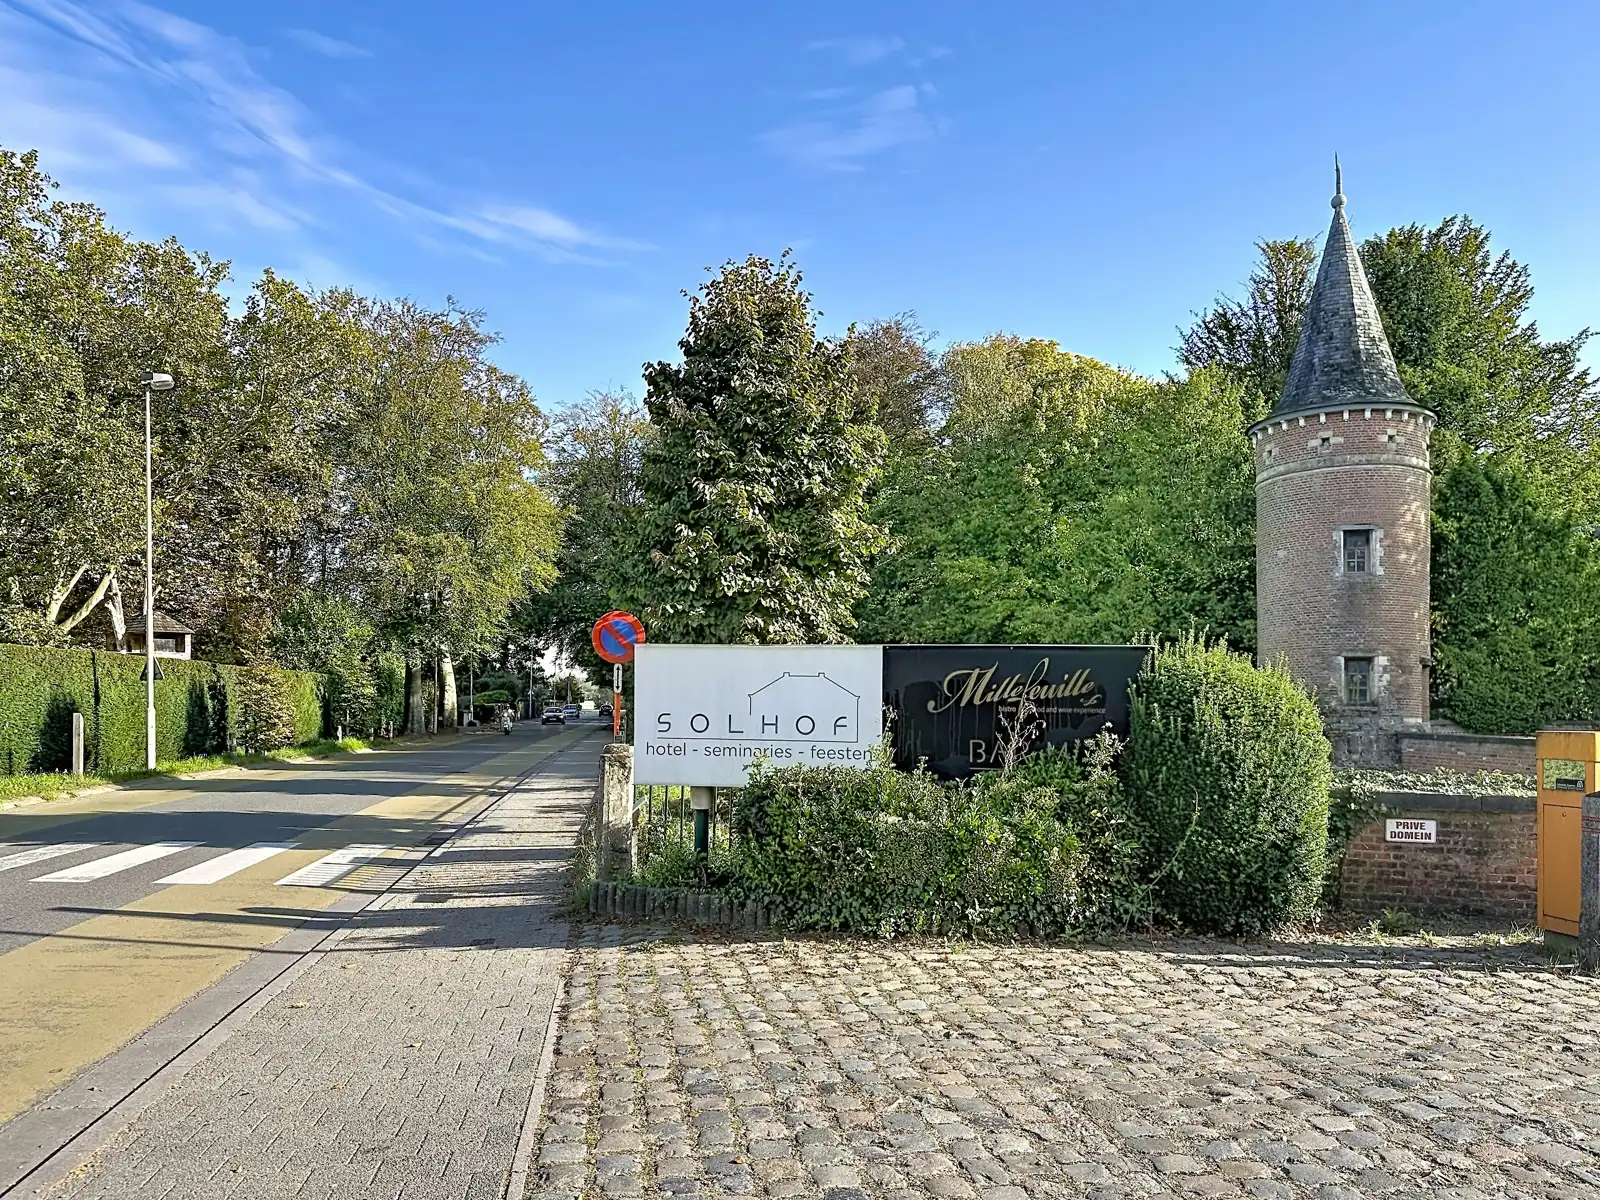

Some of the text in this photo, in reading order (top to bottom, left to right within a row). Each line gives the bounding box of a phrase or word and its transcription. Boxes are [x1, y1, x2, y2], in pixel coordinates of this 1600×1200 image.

[998, 705, 1016, 713] bistro
[1046, 705, 1057, 713] and
[1058, 706, 1073, 714] wine
[1073, 706, 1106, 715] experience
[657, 712, 848, 736] SOLHOF
[646, 741, 687, 757] hotel
[703, 742, 792, 759] seminaries
[810, 744, 873, 760] feesten
[1396, 821, 1426, 831] PRIVE
[1390, 830, 1432, 841] DOMEIN
